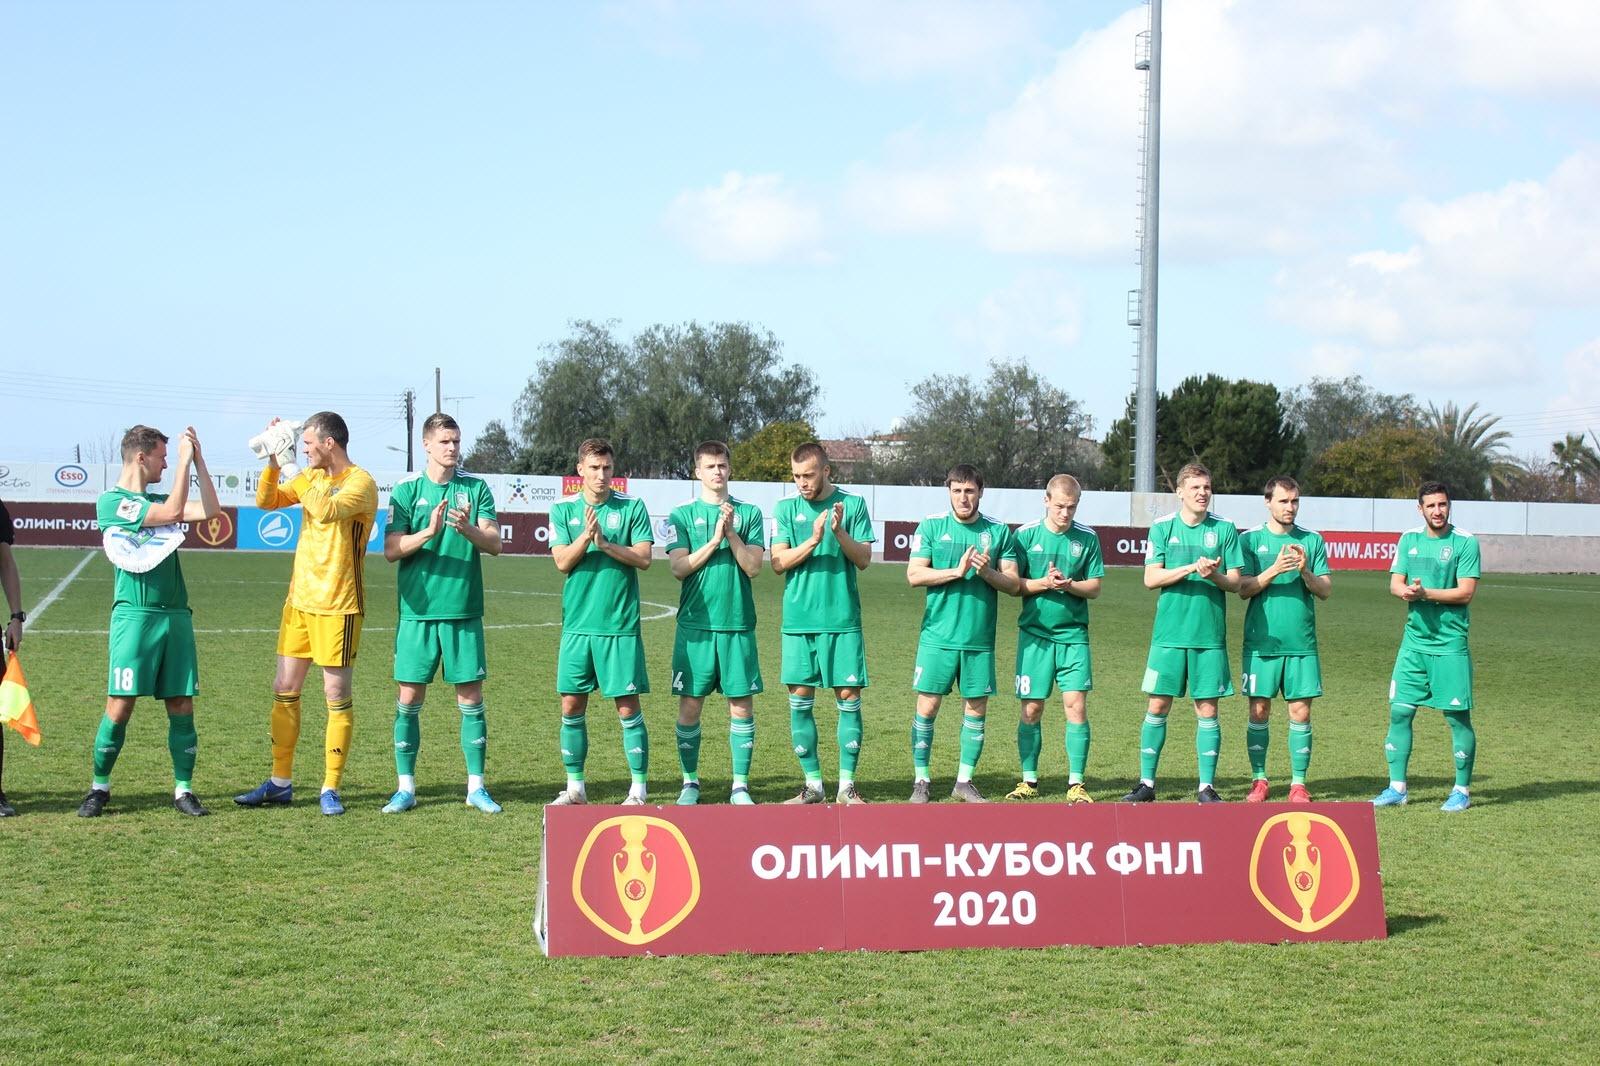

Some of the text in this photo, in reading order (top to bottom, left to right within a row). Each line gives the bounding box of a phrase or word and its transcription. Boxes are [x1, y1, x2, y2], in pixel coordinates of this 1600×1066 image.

[113, 667, 134, 691] 18
[1241, 672, 1256, 693] 21
[751, 841, 1204, 881] ОЛИМП-КУБОК ФНЛ
[933, 890, 1037, 927] 2020
